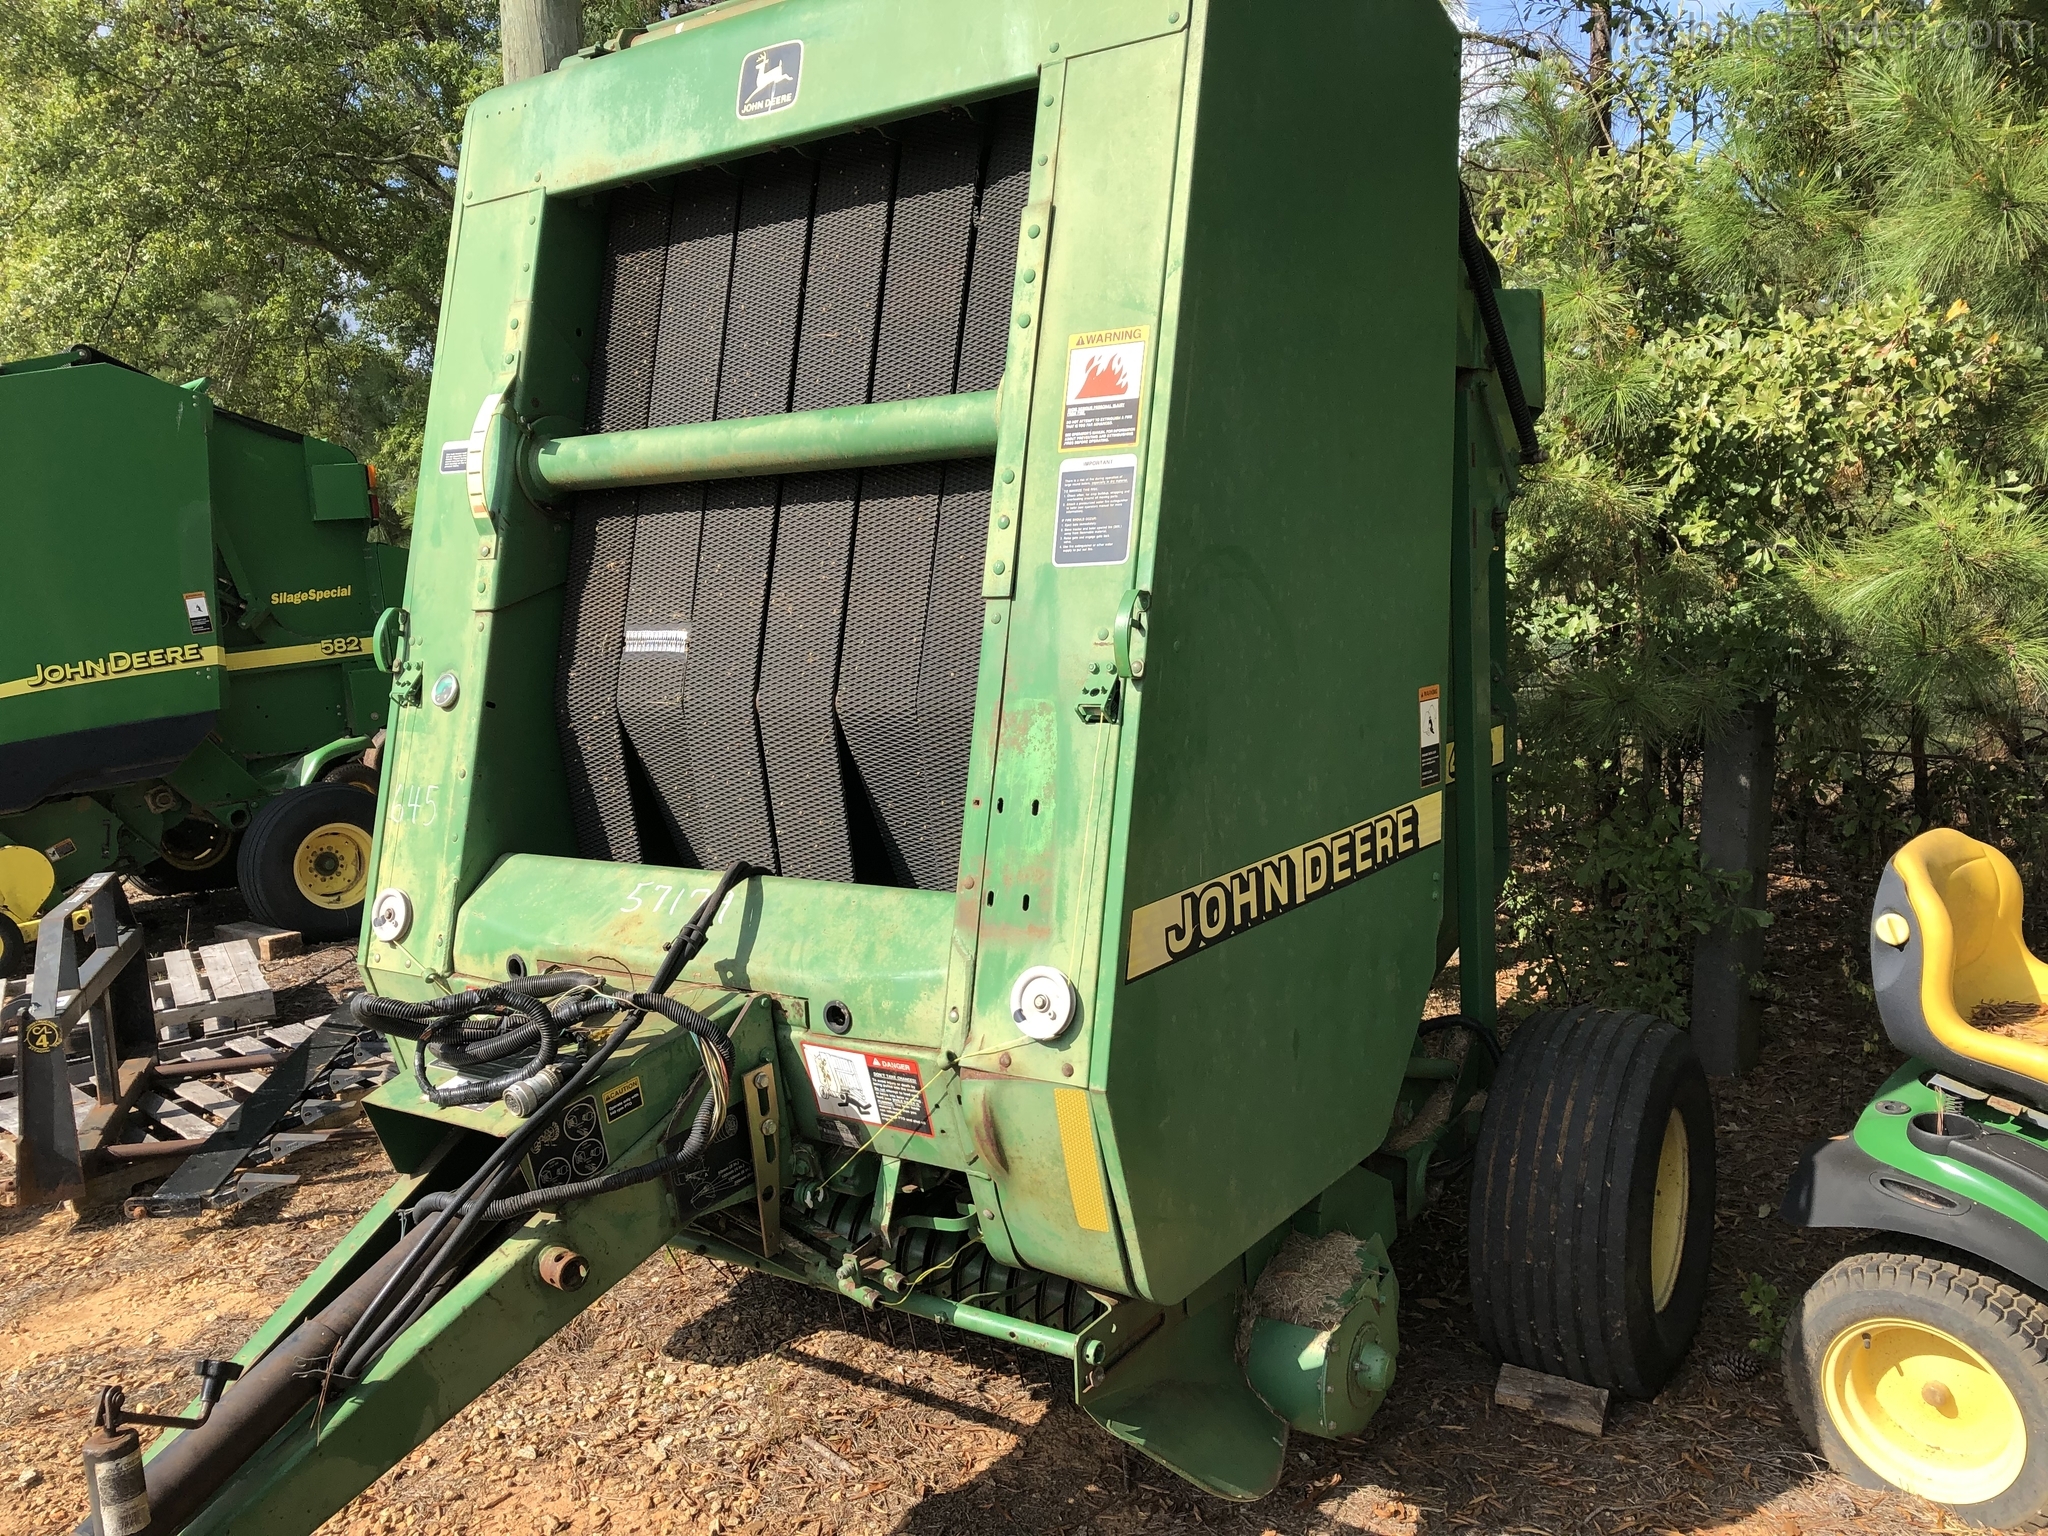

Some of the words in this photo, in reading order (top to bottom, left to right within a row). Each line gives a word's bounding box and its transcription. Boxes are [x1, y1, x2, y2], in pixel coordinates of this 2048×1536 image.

[741, 100, 764, 114] JOHN
[765, 92, 793, 108] DEERE
[1086, 328, 1142, 345] WARNING
[1083, 459, 1113, 467] IMPORTANT
[271, 585, 352, 605] SilageSpecial
[320, 637, 362, 655] 582
[27, 657, 108, 687] JOHN
[109, 643, 202, 674] DEERE
[391, 783, 439, 826] 645
[1165, 855, 1295, 958] JOHN
[1303, 805, 1418, 898] DEERE
[882, 1061, 910, 1071] DANGER
[610, 1080, 638, 1099] CAUTION
